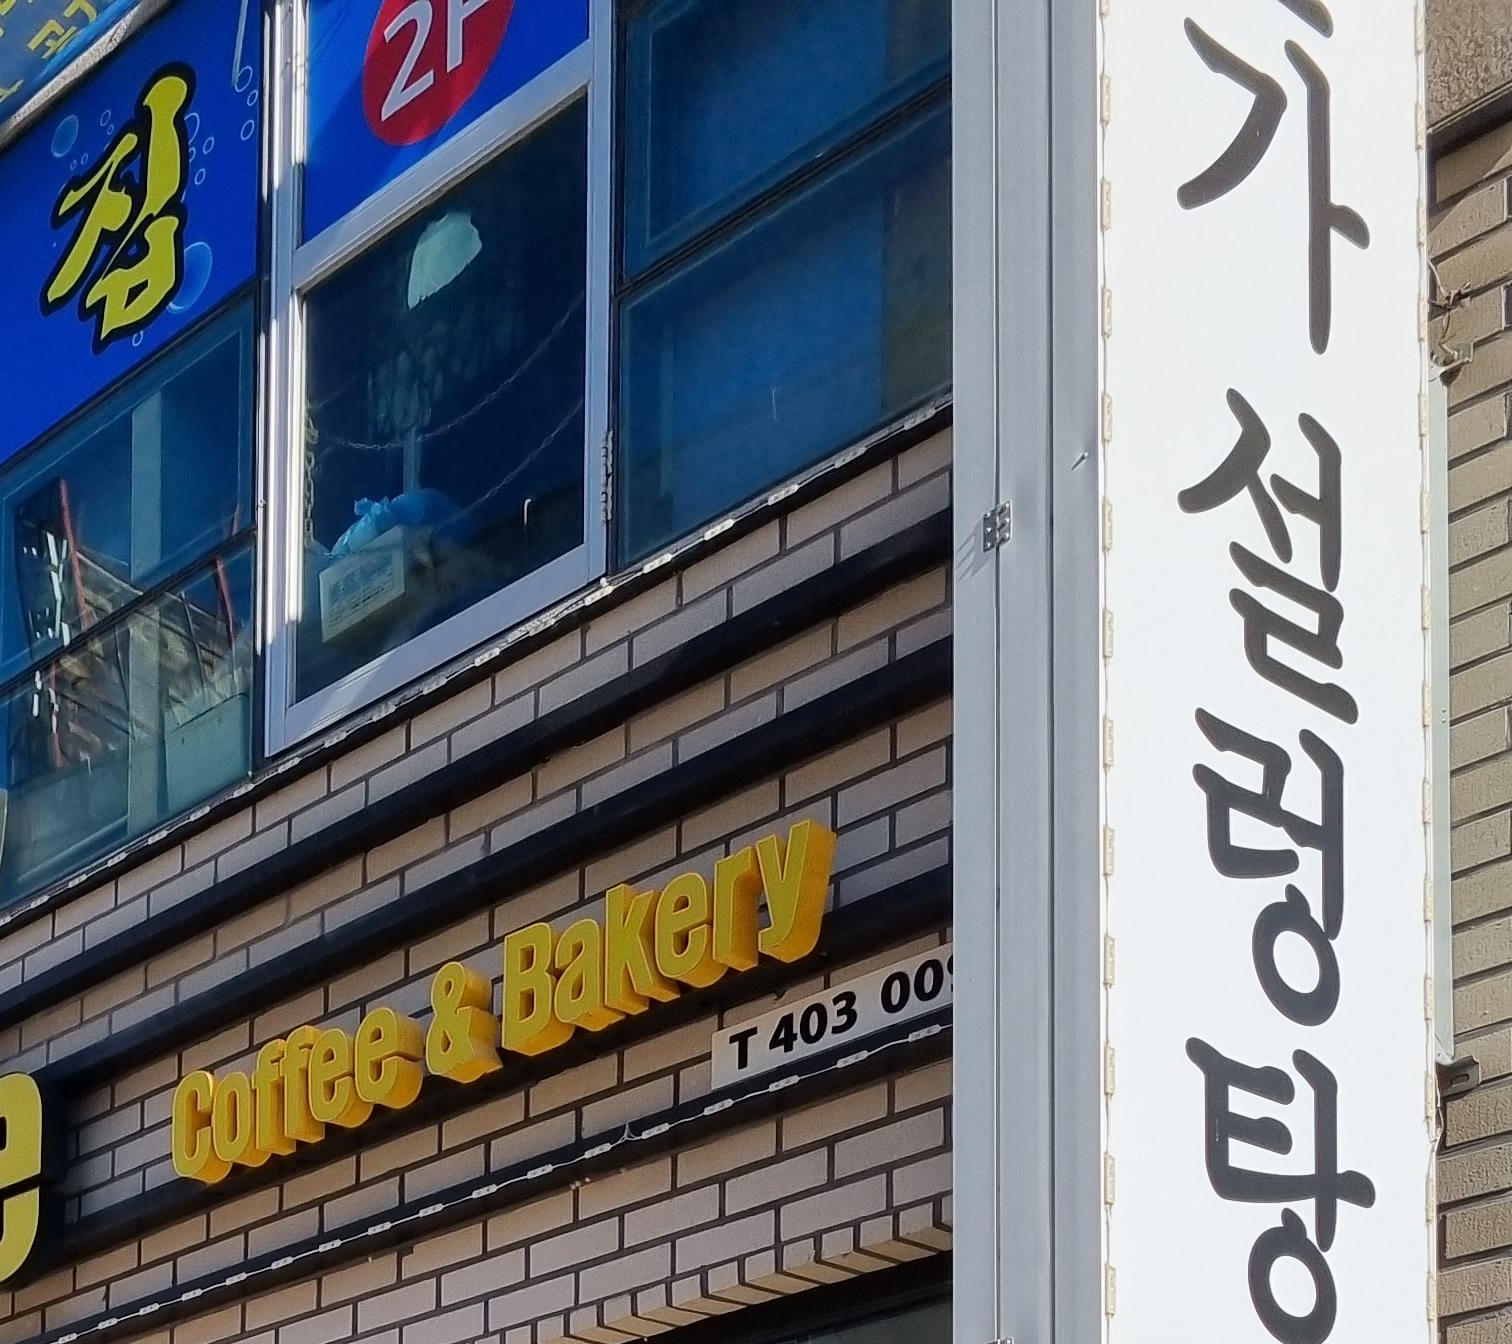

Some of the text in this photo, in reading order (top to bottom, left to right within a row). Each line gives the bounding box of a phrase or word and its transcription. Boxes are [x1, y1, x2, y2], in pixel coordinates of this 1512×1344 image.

[172, 818, 838, 1186] Coffee & Bakery
[728, 1027, 759, 1070] T
[769, 990, 859, 1057] 403
